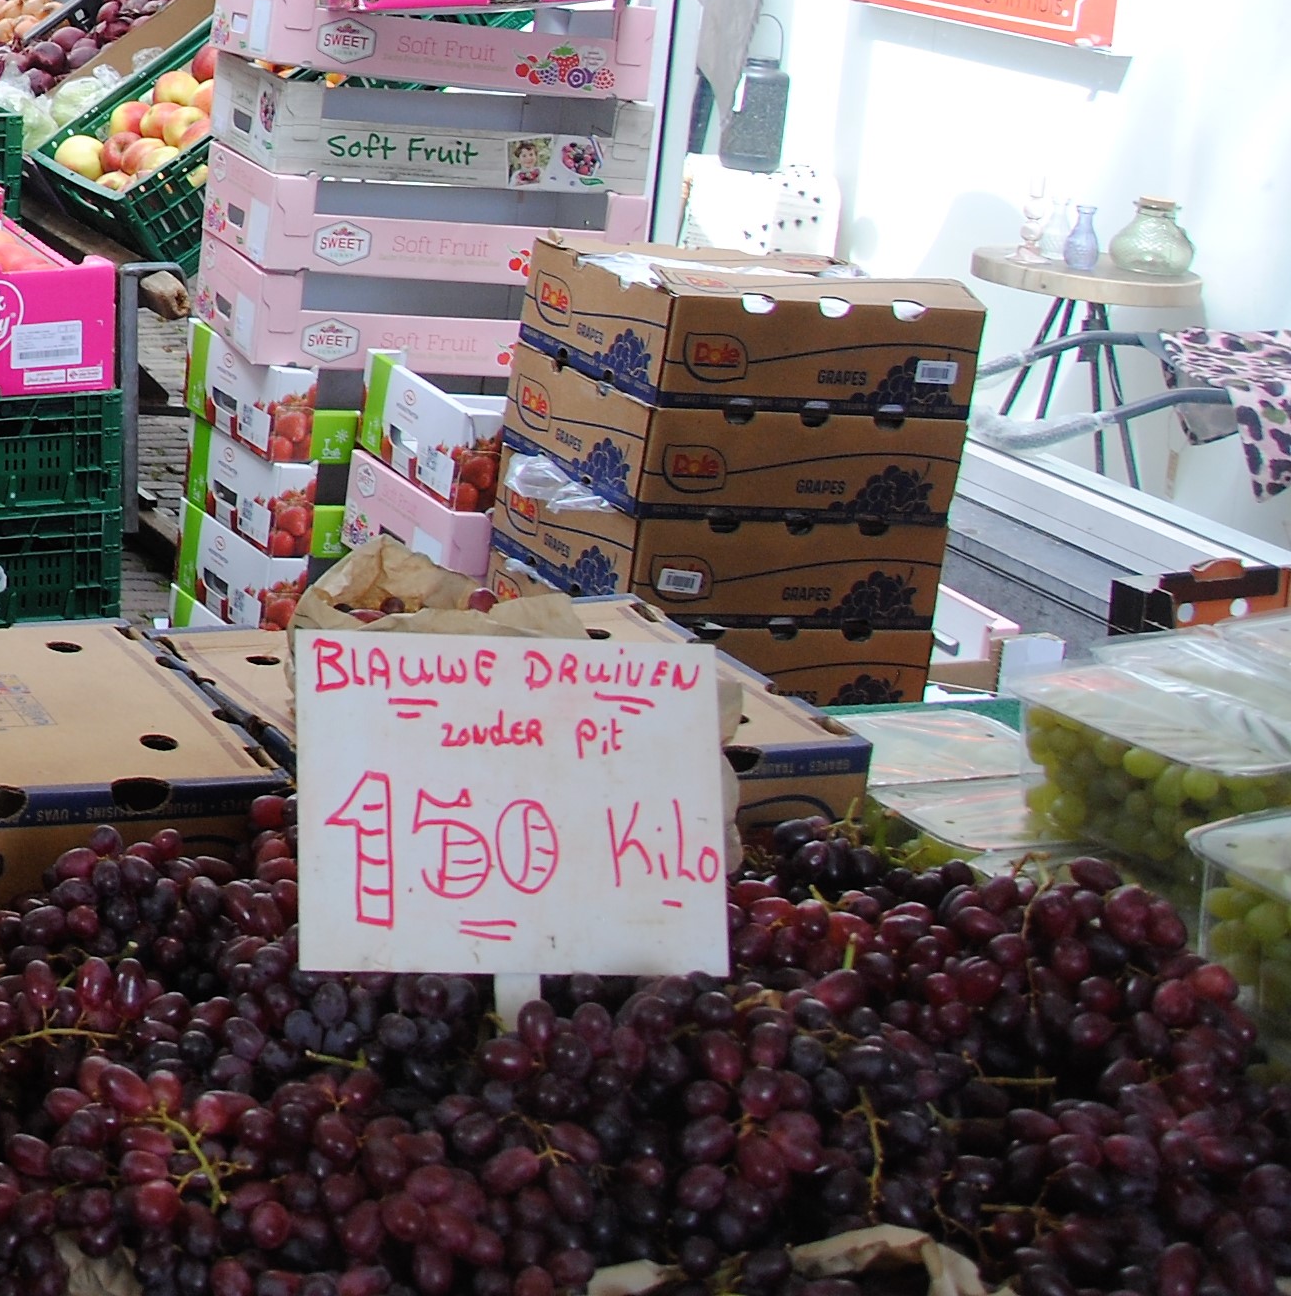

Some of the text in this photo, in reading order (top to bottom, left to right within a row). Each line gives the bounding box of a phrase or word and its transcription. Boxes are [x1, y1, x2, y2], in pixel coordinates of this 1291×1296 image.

[323, 33, 369, 50] SWEET
[397, 35, 496, 62] Soft Fruit
[327, 133, 479, 166] Soft Fruit
[320, 237, 364, 252] SWEET
[392, 235, 491, 258] Soft Fruit
[540, 281, 569, 315] Dole
[307, 334, 353, 349] SWEET
[380, 332, 478, 353] Soft Fruit
[576, 320, 604, 345] GRAPES
[693, 342, 740, 364] Dole
[817, 369, 868, 386] GRAPES
[521, 386, 549, 418] Dole
[555, 427, 582, 453] GRAPES
[672, 453, 719, 476] Dole
[796, 478, 845, 495] GRAPES
[543, 533, 570, 559] GRAPES
[782, 586, 831, 602] GRAPES
[312, 638, 700, 692] BLAUWE DRUIVEN
[36, 808, 69, 822] UVAS
[325, 770, 559, 929] 1.50
